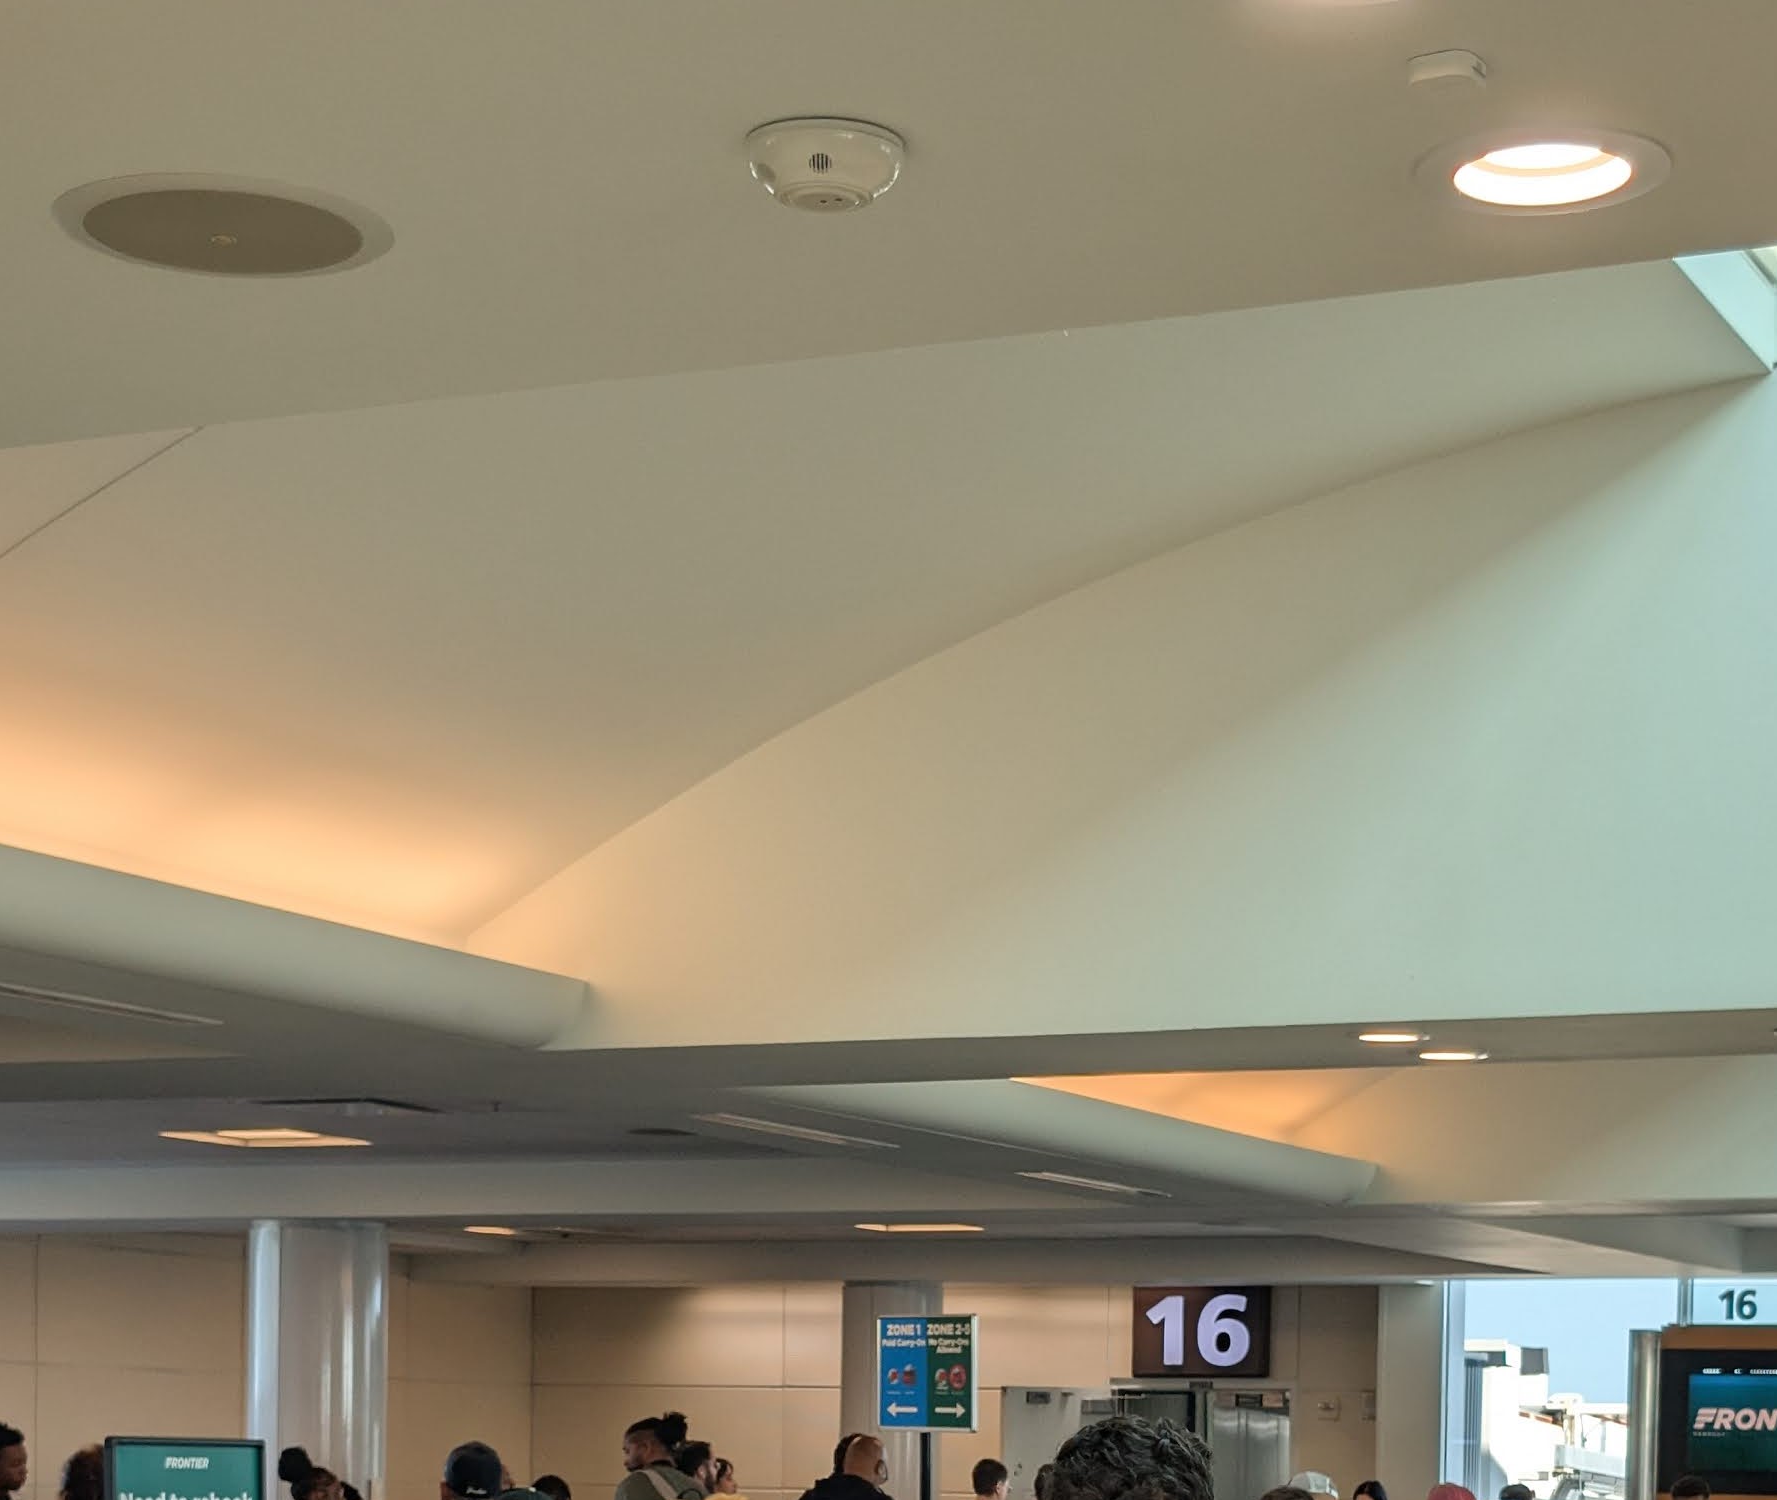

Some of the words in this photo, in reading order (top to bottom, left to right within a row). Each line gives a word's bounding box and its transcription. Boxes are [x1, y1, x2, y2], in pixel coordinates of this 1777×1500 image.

[1718, 1289, 1757, 1320] 16
[886, 1324, 914, 1336] ZONE
[927, 1324, 954, 1335] ZONE
[1146, 1294, 1250, 1366] 16
[165, 1456, 209, 1470] FRONTIER
